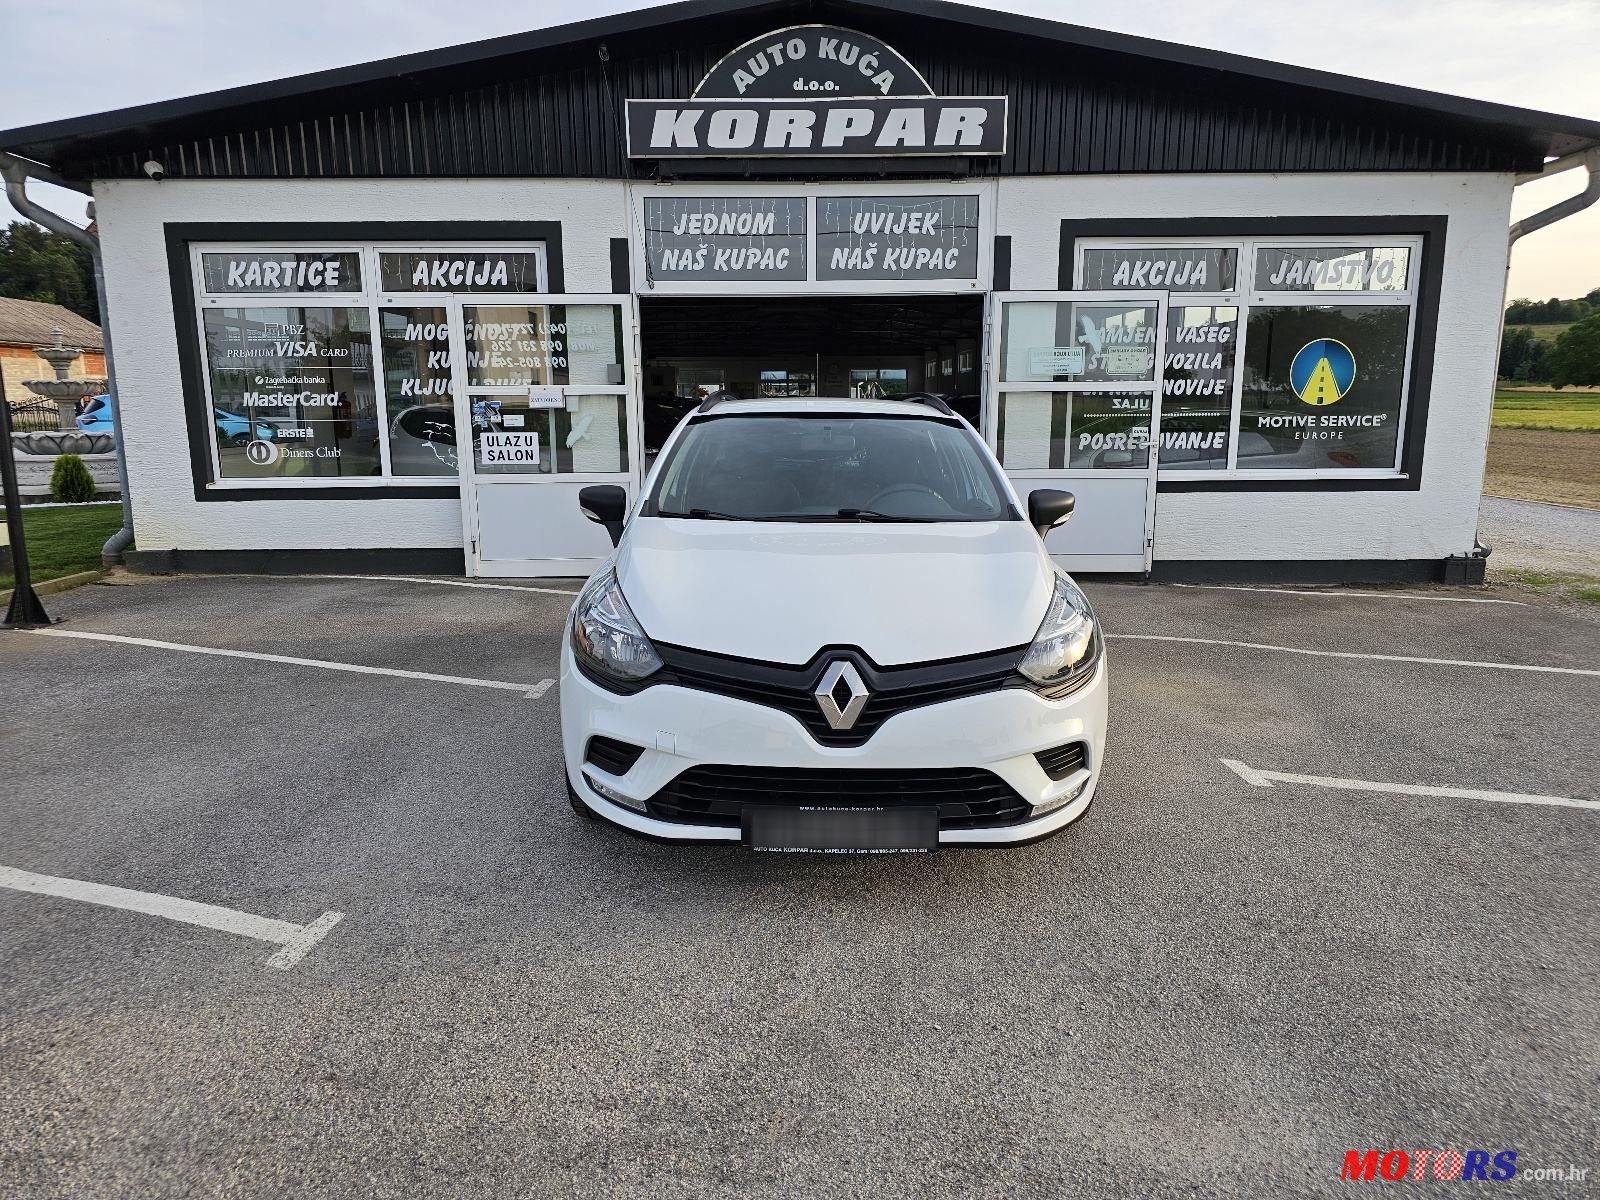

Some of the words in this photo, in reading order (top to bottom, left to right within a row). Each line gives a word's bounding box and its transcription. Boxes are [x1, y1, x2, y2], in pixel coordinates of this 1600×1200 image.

[731, 37, 806, 94] AUTO
[818, 37, 896, 95] KUĆA
[793, 78, 840, 91] d.o.o.
[649, 107, 988, 149] KORPAR
[673, 212, 776, 235] JEDNOM
[852, 212, 940, 236] UVIJEK
[661, 242, 707, 271] NAŠ
[716, 247, 791, 272] KUPAC
[831, 242, 876, 271] NAŠ
[884, 247, 959, 271] KUPAC
[227, 261, 340, 288] KARTICE
[412, 260, 509, 288] AKCIJA
[1112, 259, 1208, 287] AKCIJA
[1270, 259, 1395, 286] JAMSTVO
[281, 325, 305, 335] PBZ
[226, 349, 274, 358] PREMIUM
[273, 341, 318, 357] VISA
[320, 348, 348, 357] CARD
[1163, 379, 1226, 396] NOVIJE
[1257, 415, 1317, 428] MOTIVE
[277, 429, 306, 438] ERSTE
[486, 435, 521, 447] ULAZ
[524, 435, 533, 447] U
[1295, 432, 1343, 440] EUROPE
[280, 447, 314, 458] Diners
[487, 450, 534, 461] SALON
